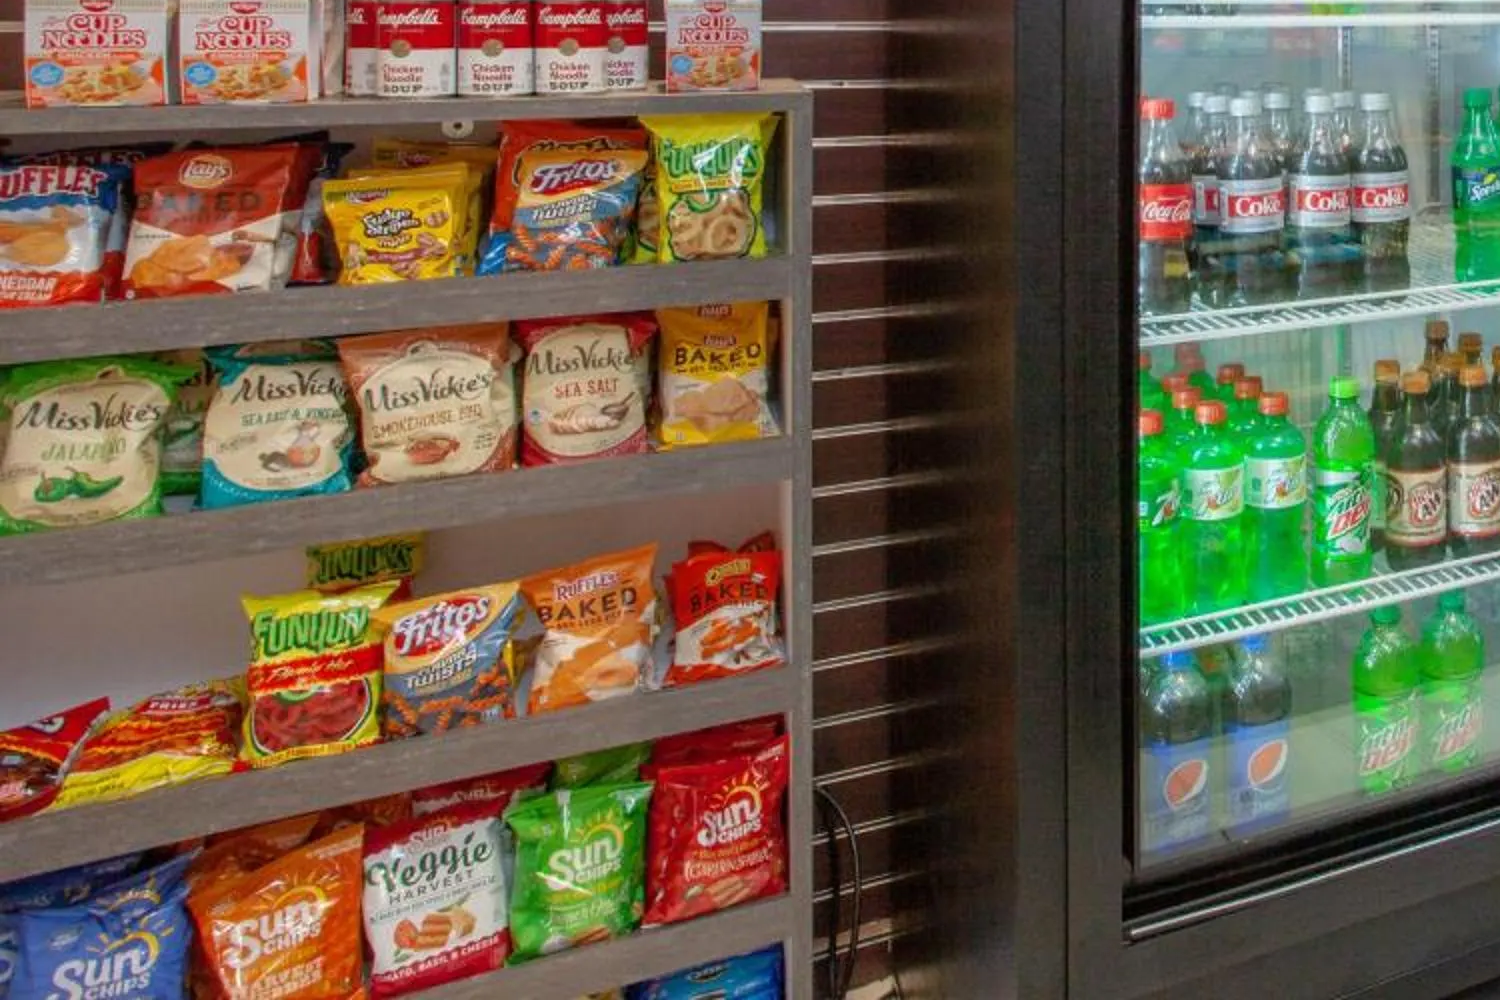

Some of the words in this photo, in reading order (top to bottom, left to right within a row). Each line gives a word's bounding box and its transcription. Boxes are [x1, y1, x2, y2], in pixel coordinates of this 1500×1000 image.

[67, 15, 126, 33] CUP
[217, 17, 272, 33] CUP
[42, 31, 146, 49] NOODLES
[195, 32, 290, 50] NOODLES
[472, 83, 513, 92] SOUP
[550, 81, 589, 90] SOUP
[607, 78, 634, 87] OUP
[531, 160, 617, 193] Fritos
[1235, 195, 1282, 217] Coke
[529, 349, 580, 376] Miss
[674, 343, 762, 367] BAKED
[230, 374, 297, 405] Miss
[363, 383, 421, 412] Miss
[411, 367, 491, 401] Vickie's
[553, 383, 583, 398] SEA
[587, 378, 619, 396] SALT
[15, 400, 91, 431] Miss
[537, 586, 637, 623] BAKED
[253, 607, 371, 657] FUNYUN
[393, 596, 489, 655] Fritos
[696, 799, 761, 847] Sun
[366, 830, 491, 893] Veggie
[544, 837, 623, 891] Sun
[389, 869, 474, 906] HARVEST
[222, 899, 327, 969] Sun
[45, 949, 153, 1000] Sun
[84, 972, 151, 1000] CHIPS
